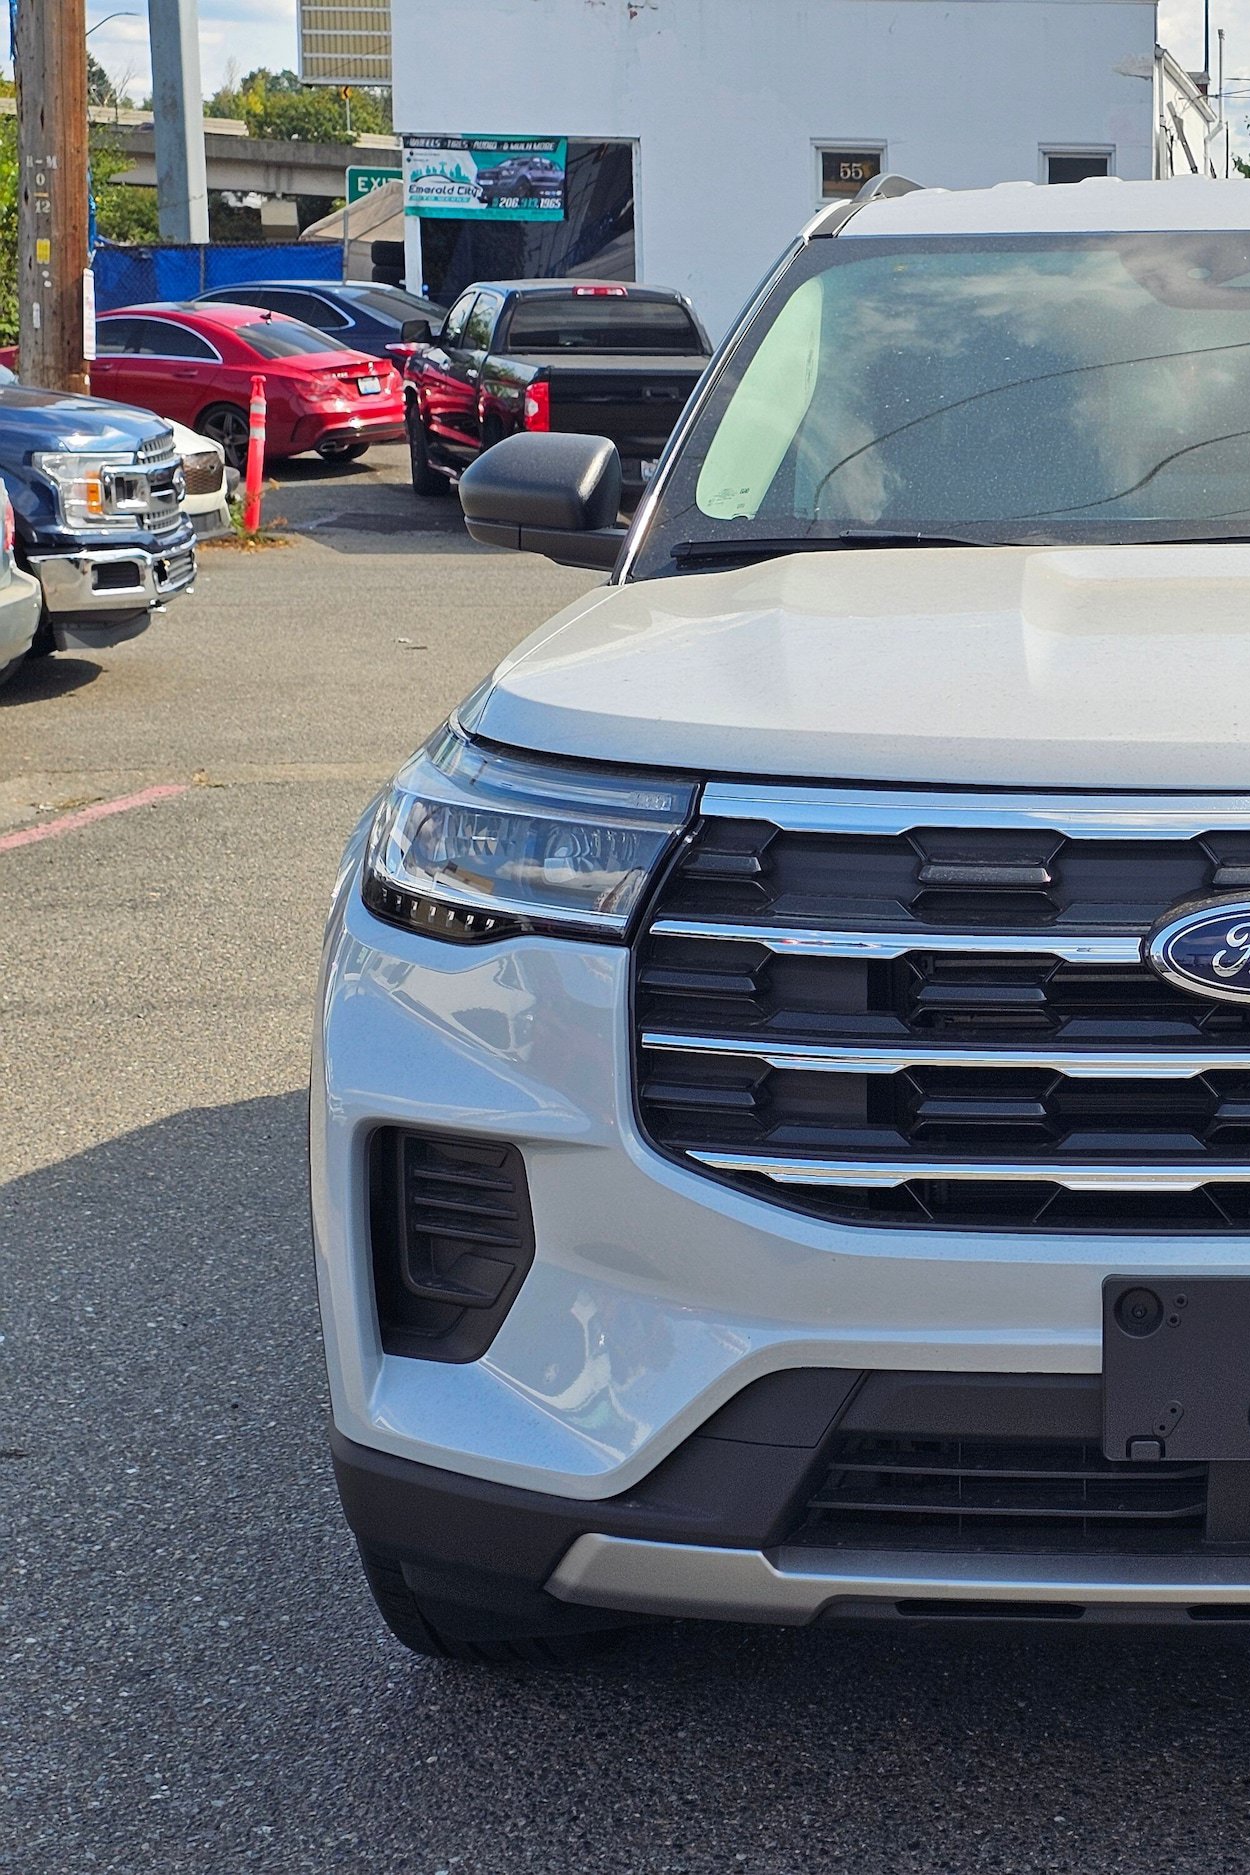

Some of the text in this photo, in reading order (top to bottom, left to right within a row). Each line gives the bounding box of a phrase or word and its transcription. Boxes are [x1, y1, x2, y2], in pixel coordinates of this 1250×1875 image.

[840, 162, 863, 180] 55
[408, 184, 479, 198] Emerald City
[35, 199, 51, 213] 12
